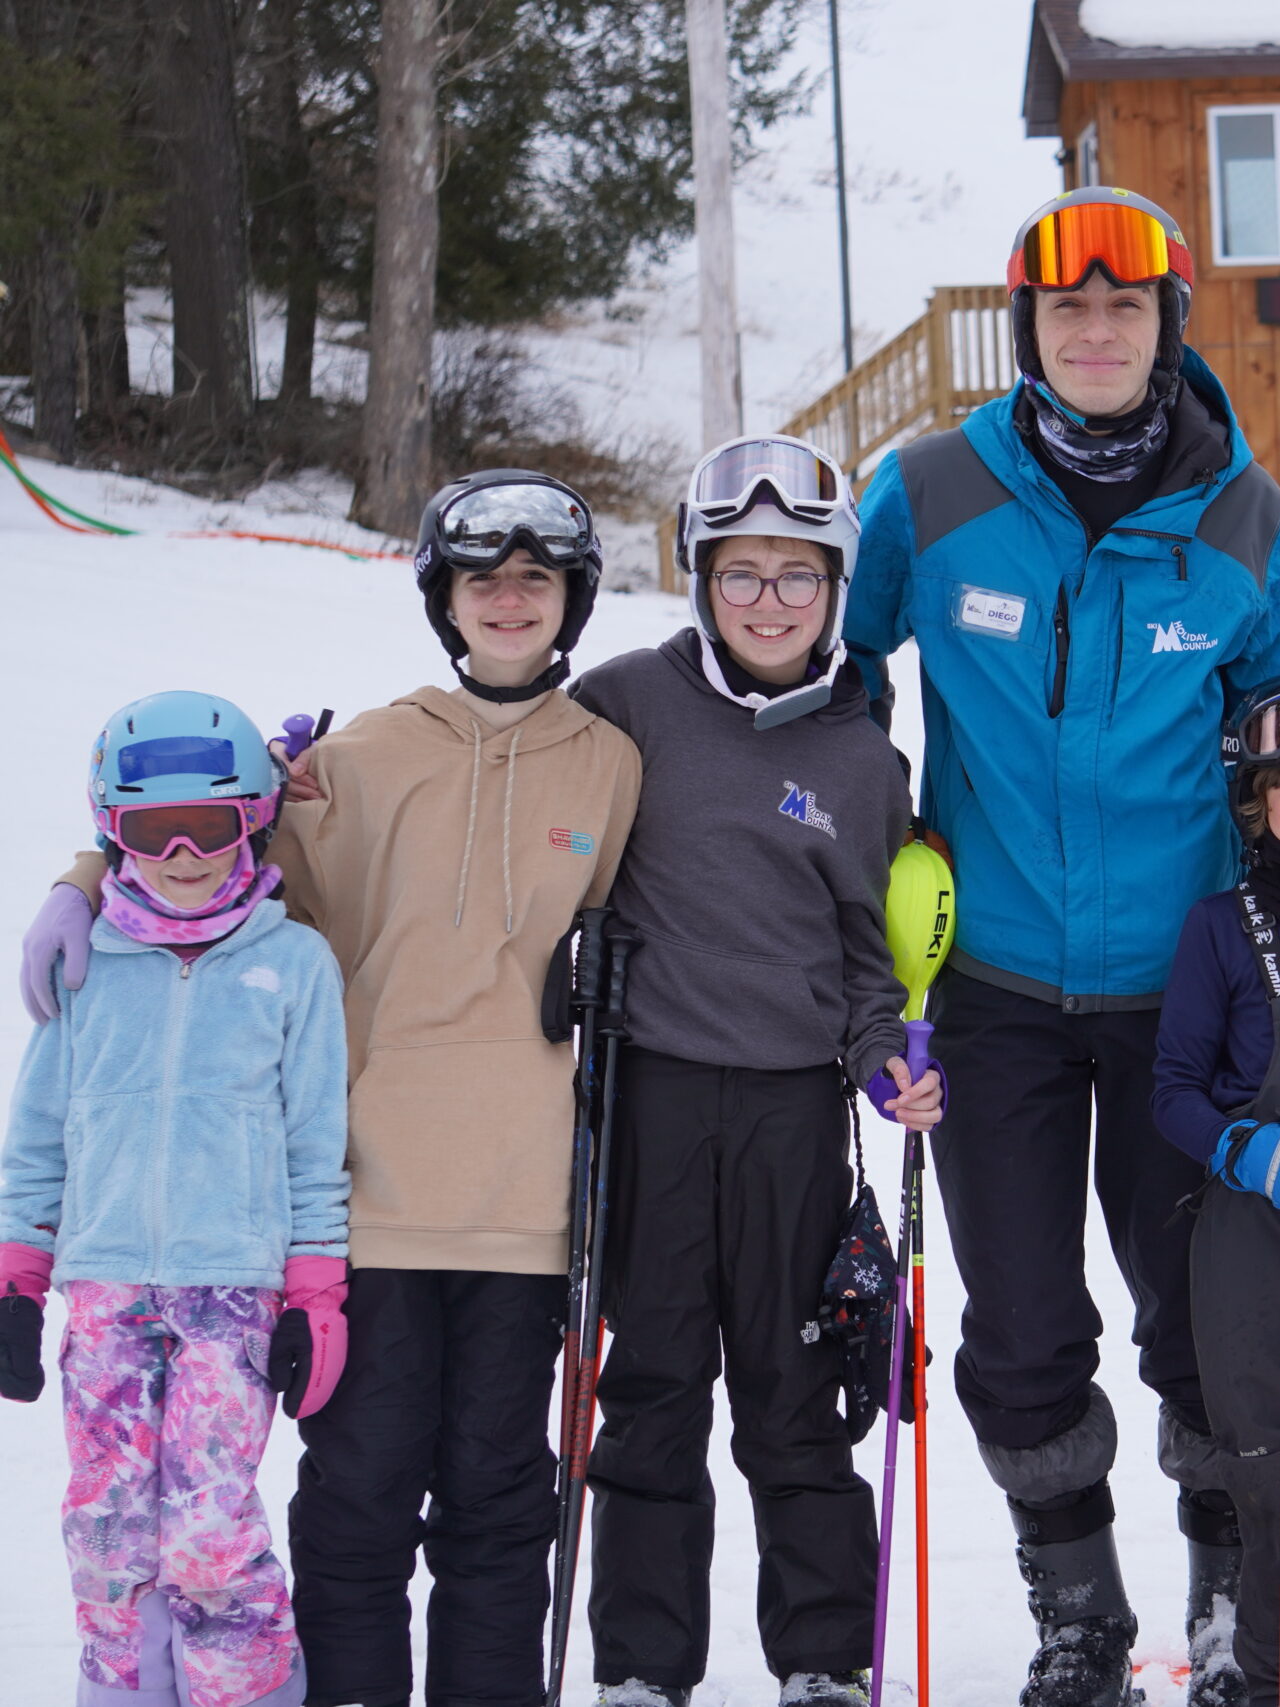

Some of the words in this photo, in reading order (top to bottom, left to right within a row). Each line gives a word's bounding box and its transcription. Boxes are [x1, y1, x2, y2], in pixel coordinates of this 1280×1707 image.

[988, 610, 1018, 622] DIEGO
[1173, 620, 1208, 642] HOLIDAY
[210, 786, 241, 796] GIRO
[926, 890, 950, 959] LEKI
